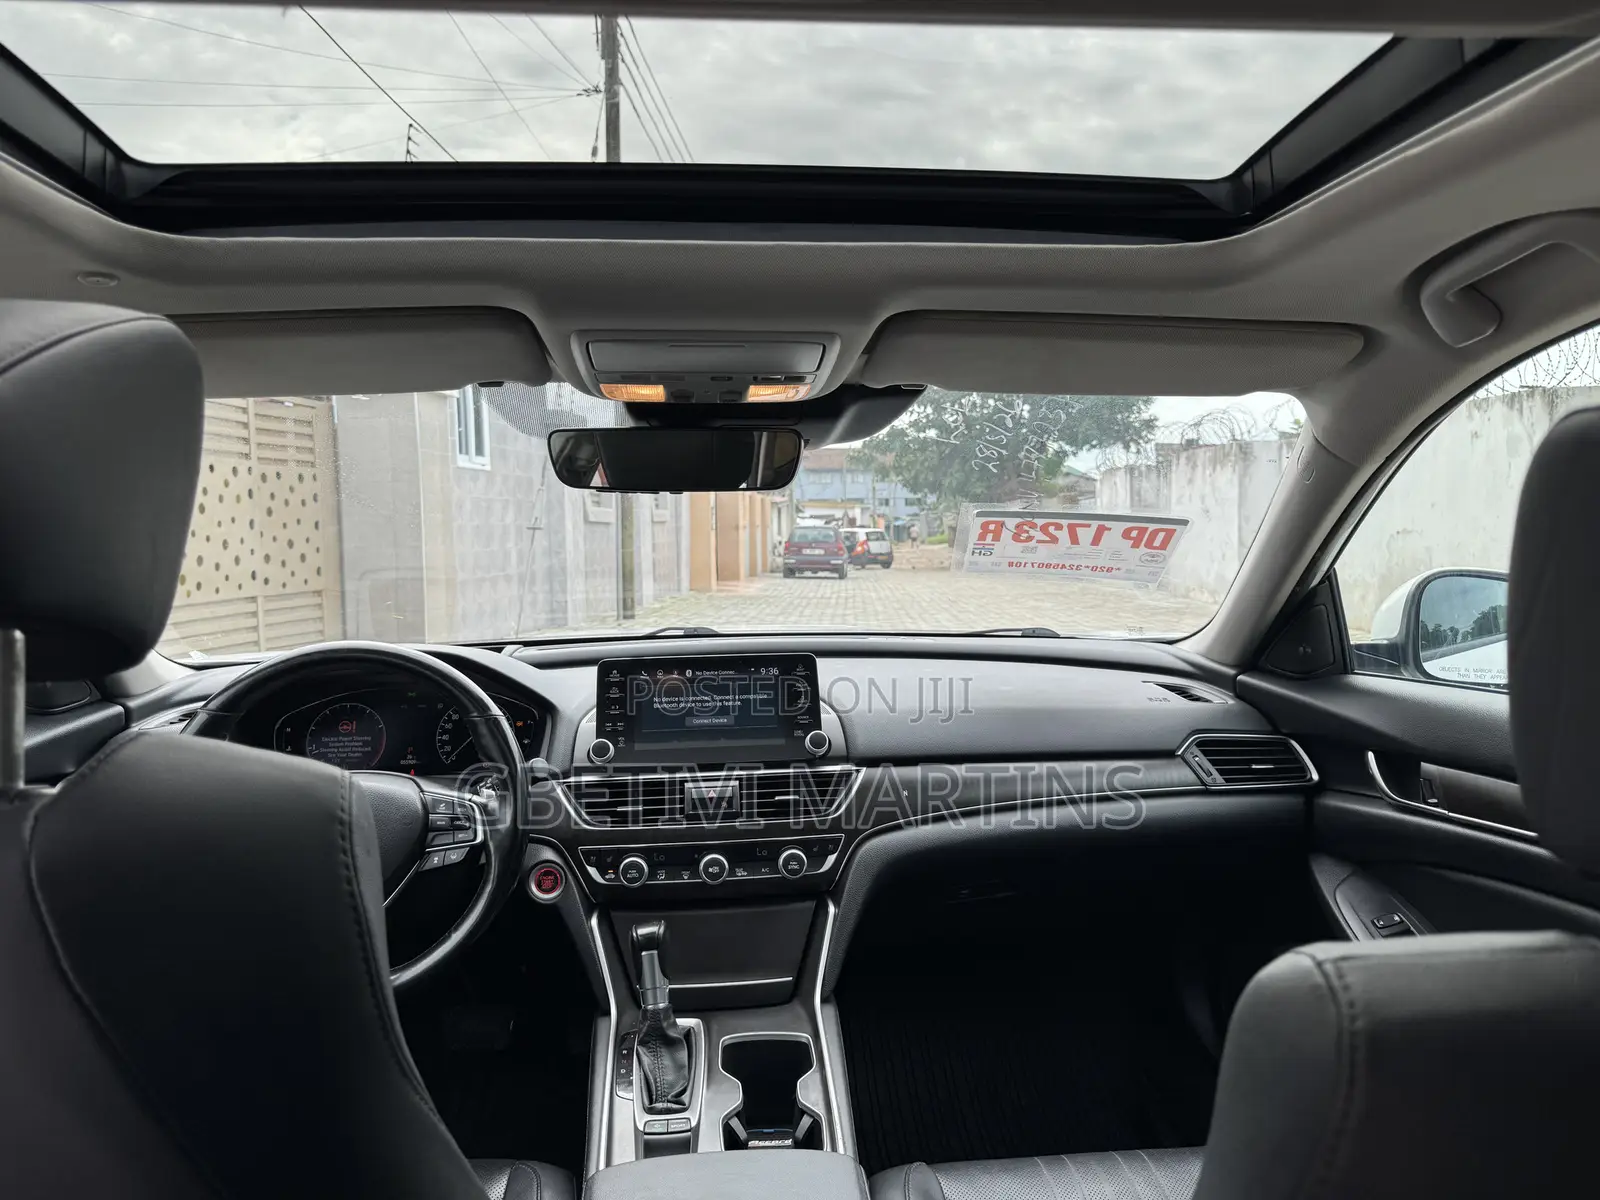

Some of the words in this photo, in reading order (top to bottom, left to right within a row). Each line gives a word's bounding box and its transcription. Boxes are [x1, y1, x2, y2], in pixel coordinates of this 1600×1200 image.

[760, 667, 779, 676] 9:36
[756, 848, 768, 856] Lo
[653, 853, 665, 861] Lo
